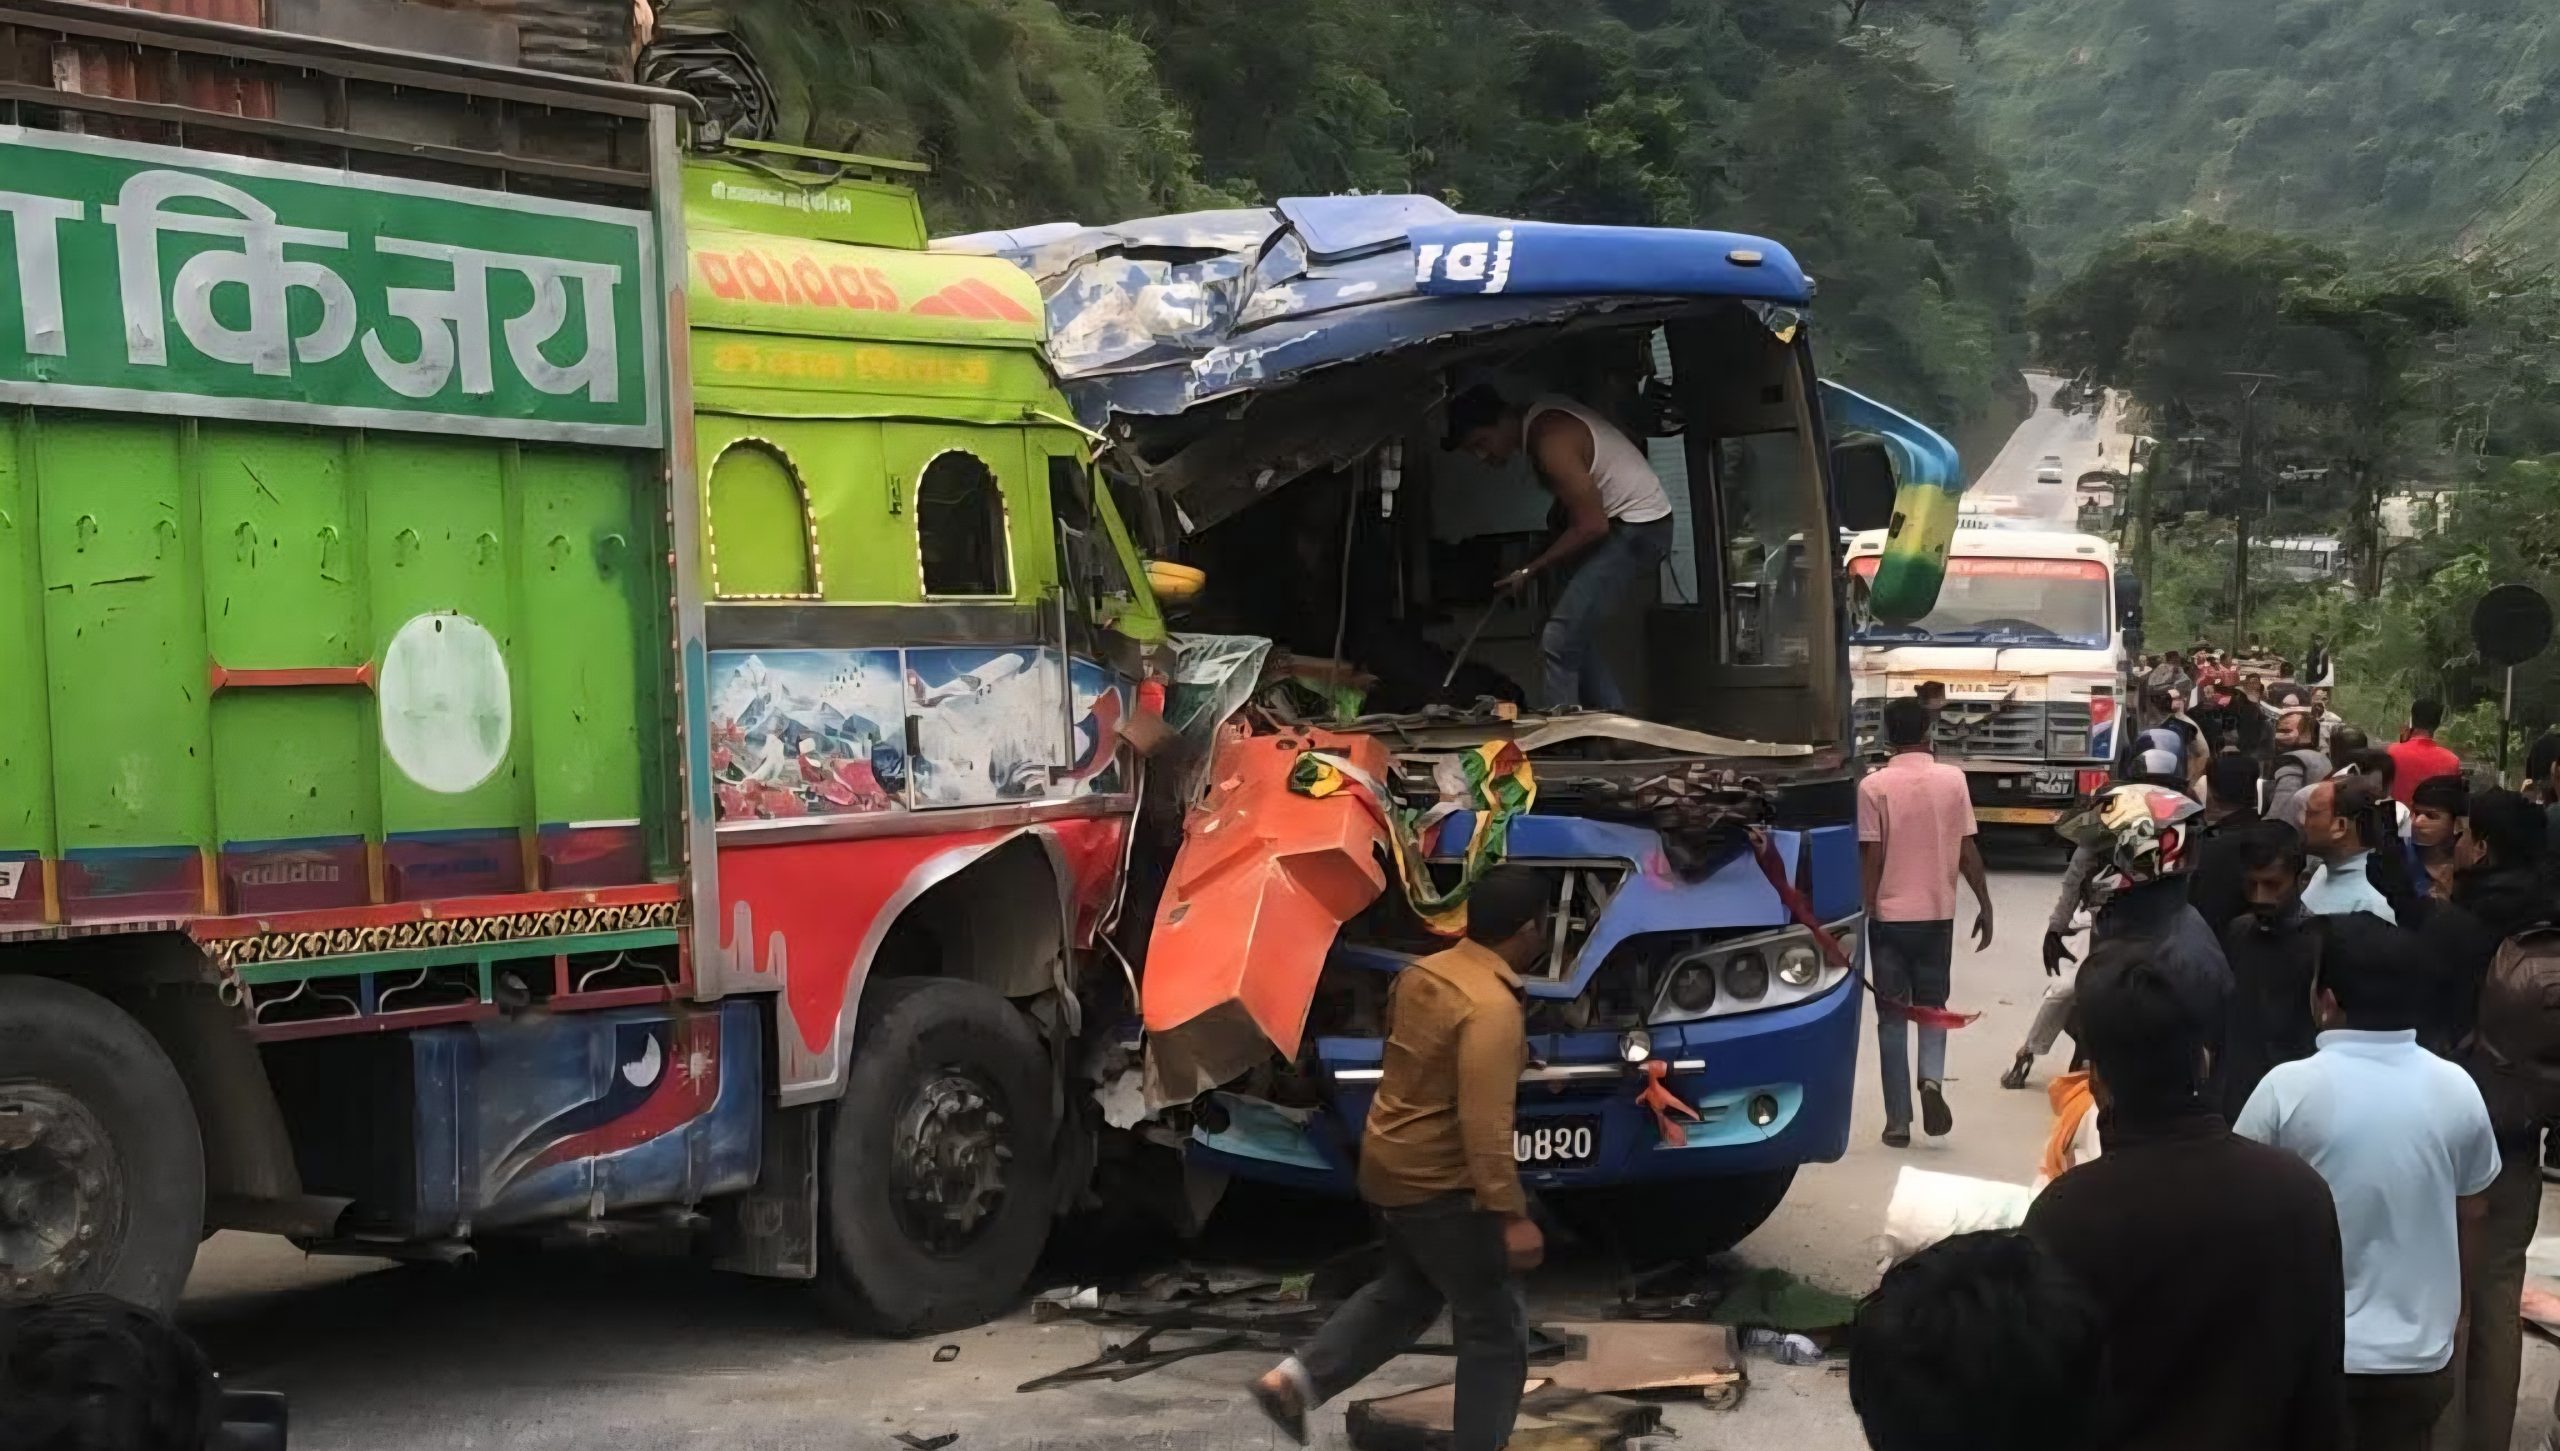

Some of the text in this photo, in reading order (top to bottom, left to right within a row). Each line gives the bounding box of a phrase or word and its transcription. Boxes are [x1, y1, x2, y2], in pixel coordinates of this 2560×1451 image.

[697, 248, 900, 312] adidas
[1416, 229, 1513, 294] raj
[360, 235, 622, 403] जय
